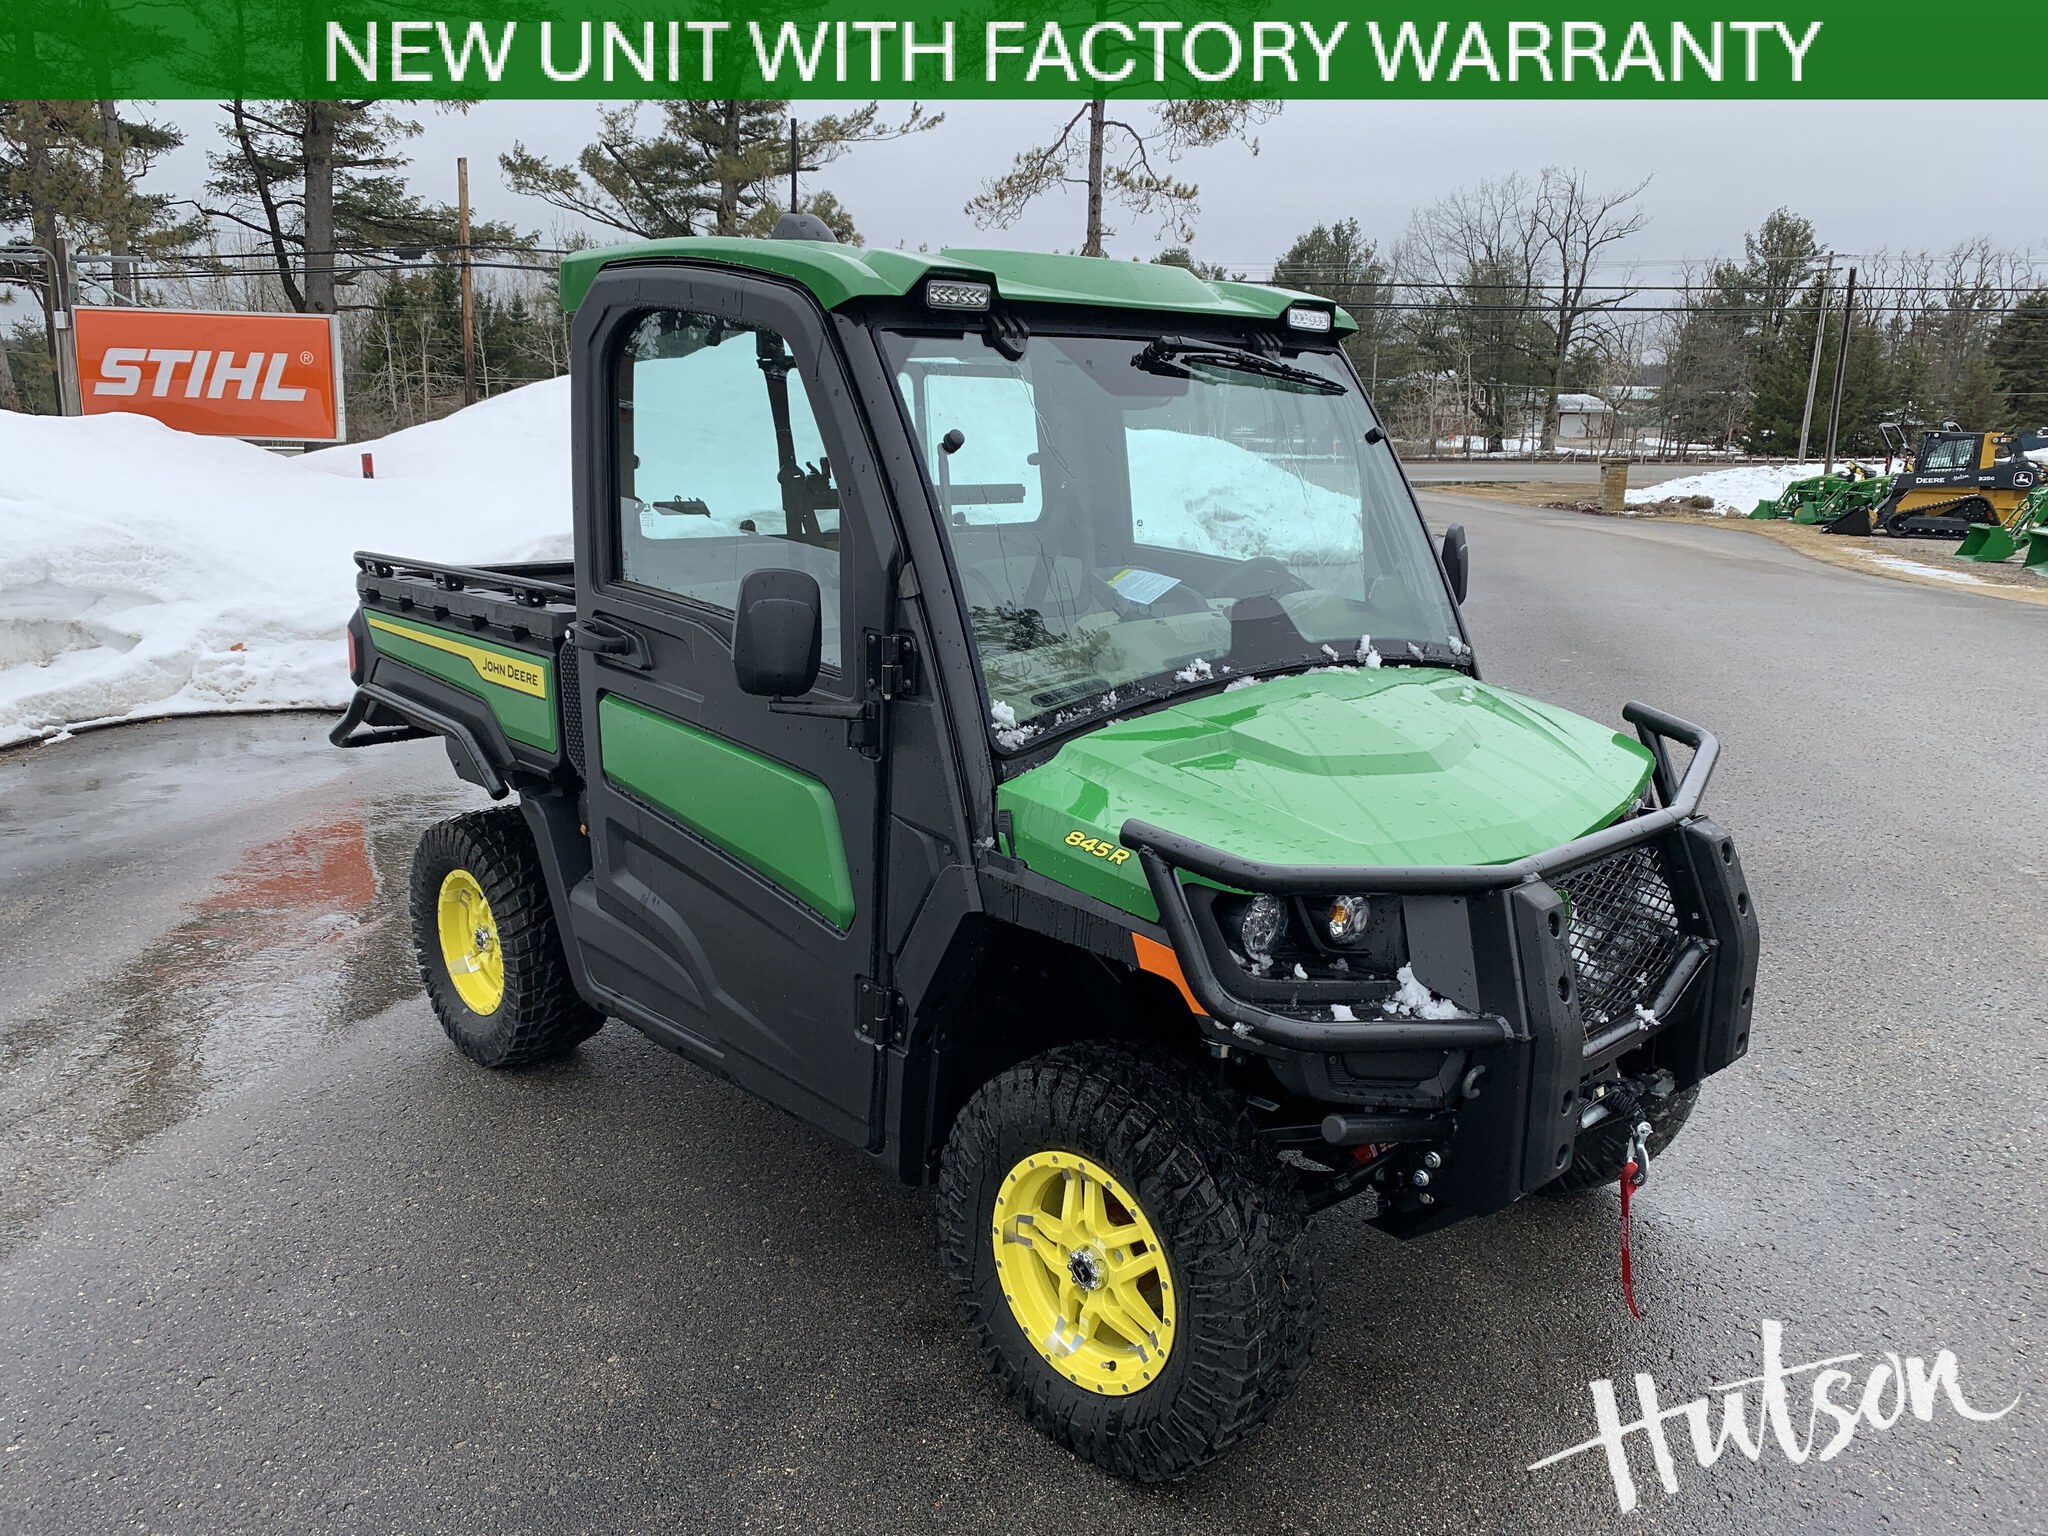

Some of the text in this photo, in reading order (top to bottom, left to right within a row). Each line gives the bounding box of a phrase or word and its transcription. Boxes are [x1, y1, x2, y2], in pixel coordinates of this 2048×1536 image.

[483, 657, 538, 687] JOHN DEERE
[1064, 829, 1132, 867] 845R
